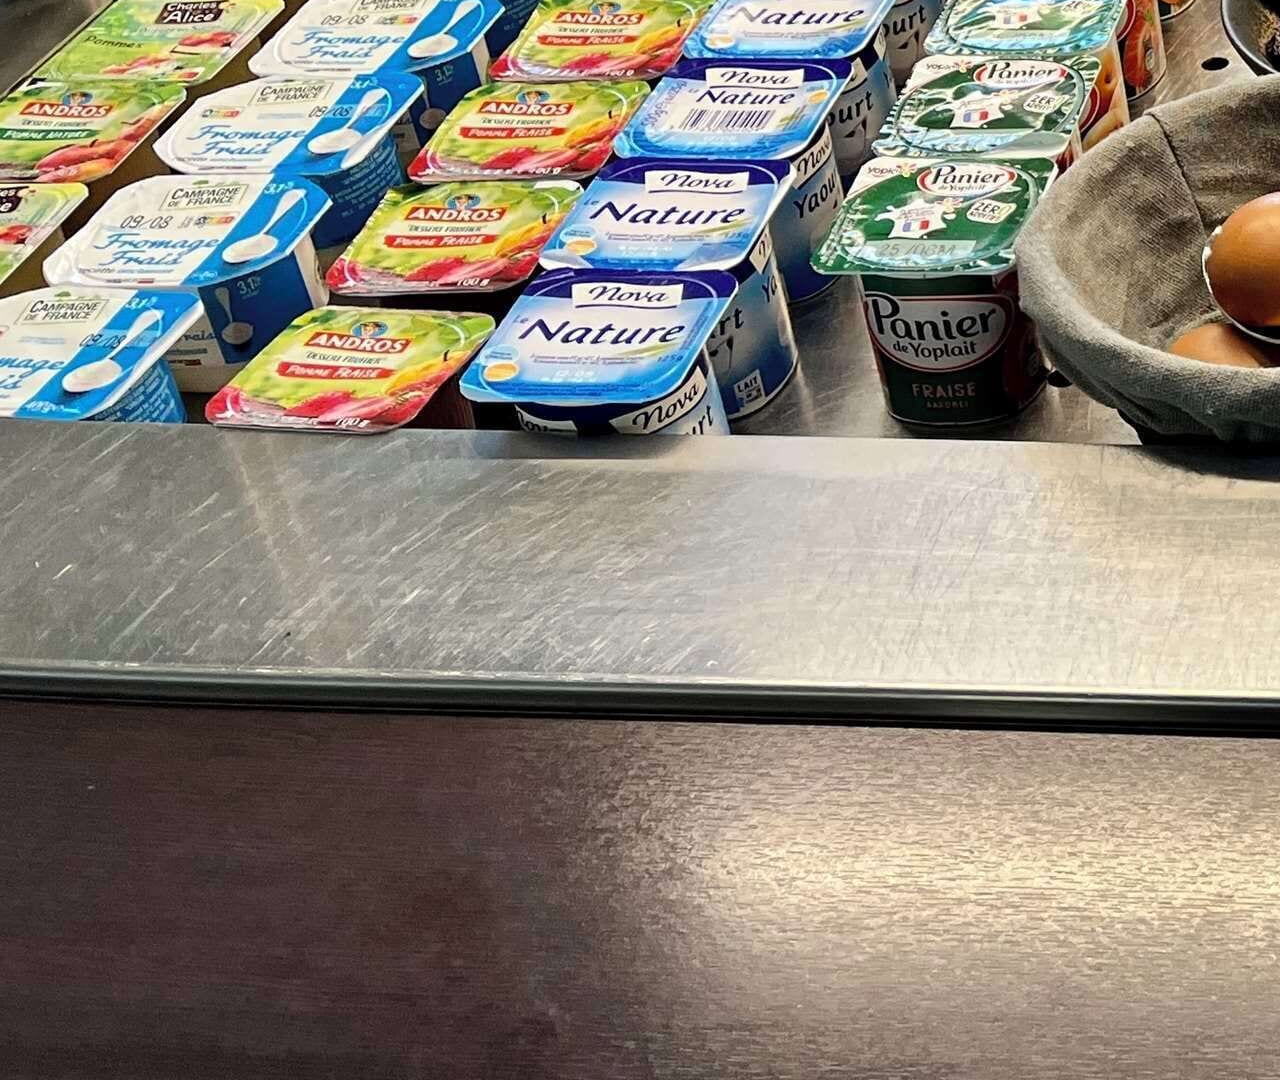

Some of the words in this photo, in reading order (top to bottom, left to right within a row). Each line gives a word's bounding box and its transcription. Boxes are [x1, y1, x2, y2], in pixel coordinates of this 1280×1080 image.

[166, 1, 217, 11] Charles
[165, 10, 215, 23] Alice
[557, 12, 642, 25] ANDROS
[733, 5, 866, 26] Nature
[84, 36, 143, 49] Pommes
[292, 30, 406, 48] Fromage
[300, 46, 374, 60] Frais
[719, 70, 791, 86] Nova
[987, 62, 1057, 80] Panier
[260, 85, 324, 97] CAMPAGNE
[274, 91, 318, 102] FRANCE
[695, 88, 796, 107] Nature
[29, 103, 110, 117] ANDROS
[480, 101, 569, 116] ANDROS
[187, 125, 308, 145] Fromage
[468, 128, 511, 138] POMME
[513, 127, 553, 138] FRAISE
[194, 141, 273, 156] Frais
[659, 172, 736, 190] Nova
[932, 165, 1006, 185] Panier
[172, 187, 240, 200] CAMPAGNE
[187, 195, 234, 207] FRANCE
[793, 171, 837, 219] Yaou
[406, 206, 501, 221] ANDROS
[590, 200, 746, 225] Nature
[94, 232, 218, 253] Fromage
[392, 235, 438, 247] POMME
[441, 235, 485, 246] FRAISE
[100, 250, 183, 266] Frais
[587, 285, 670, 303] Nova
[30, 300, 99, 313] CAMPAGNE
[44, 311, 93, 320] FRANCE
[872, 295, 997, 344] Panier
[518, 318, 686, 346] Nature
[308, 333, 407, 354] ANDROS
[892, 342, 909, 354] de
[908, 342, 977, 361] Yoplait
[0, 357, 64, 378] mage
[285, 364, 329, 378] POMME
[334, 366, 381, 379] FRAISE
[737, 375, 759, 394] LAIT
[912, 381, 977, 400] FRAISE
[632, 382, 700, 432] Nova
